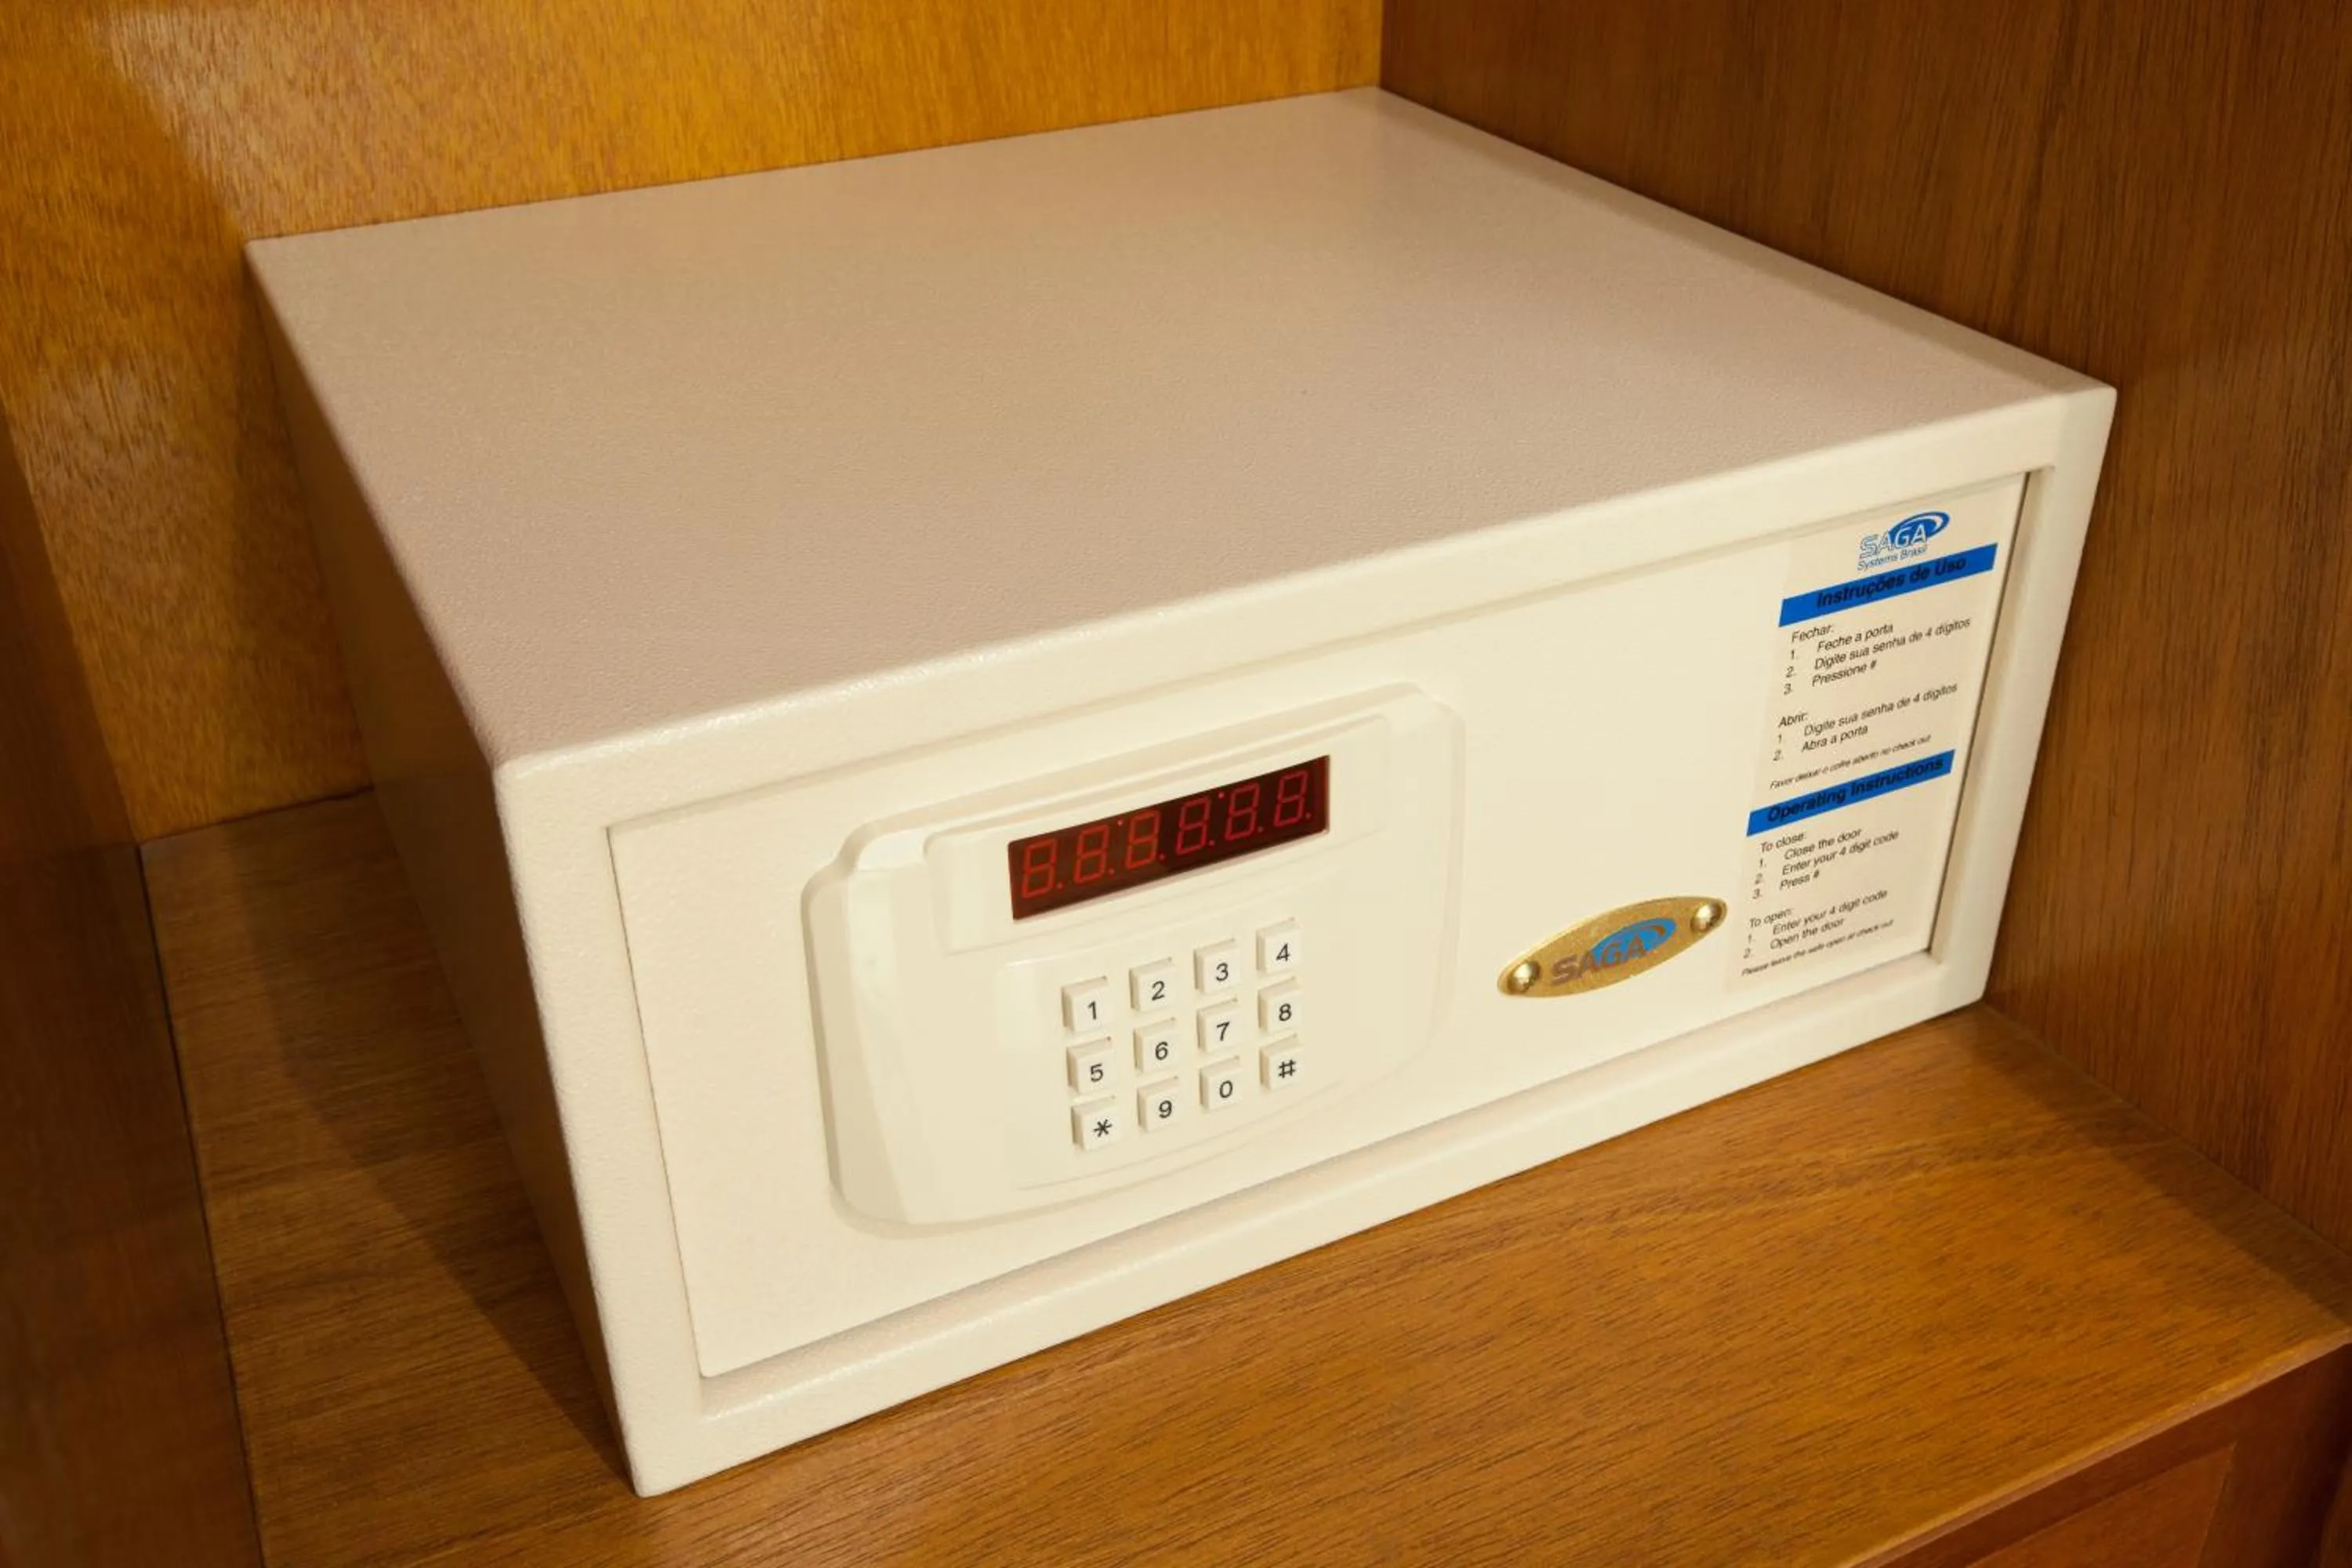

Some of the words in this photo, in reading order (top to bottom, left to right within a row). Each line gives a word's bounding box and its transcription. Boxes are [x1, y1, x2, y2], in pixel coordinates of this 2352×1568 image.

[1859, 523, 1928, 559] SAGA
[1857, 553, 1898, 572] Systems
[1900, 545, 1927, 561] Brasil
[1816, 573, 1905, 608] Instruções
[1909, 563, 1931, 584] de
[1934, 557, 1968, 576] Uso
[1814, 652, 1846, 670] Digite
[1849, 647, 1871, 660] sua
[1872, 636, 1906, 654] senha
[1908, 630, 1923, 644] de
[1925, 627, 1933, 638] 4
[1817, 635, 1853, 652] Feche
[1854, 633, 1863, 643] a
[1864, 623, 1894, 641] porta
[1812, 664, 1867, 687] Pressione
[1869, 659, 1878, 670] #
[1777, 711, 1809, 728] Abrir:
[1803, 720, 1836, 736] Digite
[1838, 713, 1859, 727] sua
[1860, 702, 1895, 720] senha
[1896, 697, 1911, 710] de
[1912, 691, 1921, 703] 4
[1801, 738, 1828, 753] Abra
[1830, 734, 1838, 745] a
[1840, 725, 1868, 745] porta
[1892, 739, 1916, 753] check
[1768, 790, 1846, 822] Operating
[1760, 841, 1774, 853] To
[1782, 858, 1812, 876] Enter
[1813, 851, 1838, 868] your
[1839, 846, 1846, 856] 4
[1849, 839, 1871, 855] digit
[1872, 830, 1900, 847] code
[1784, 843, 1816, 860] Close
[1818, 837, 1835, 850] the
[1837, 828, 1863, 844] door
[1780, 873, 1811, 891] Press
[1812, 869, 1820, 880] #
[1749, 916, 1762, 929] To
[1773, 917, 1802, 935] Enter
[1803, 909, 1827, 927] your
[1828, 904, 1836, 916] 4
[1838, 897, 1861, 913] digit
[1861, 888, 1889, 906] code
[1769, 933, 1800, 950] Open
[1802, 927, 1819, 939] the
[1820, 917, 1846, 933] door
[1550, 933, 1648, 987] SAGA
[1741, 963, 1769, 977] Please
[1770, 954, 1792, 967] leave
[1793, 949, 1806, 960] the
[1825, 935, 1846, 950] open
[1856, 924, 1880, 938] check
[1087, 1000, 1098, 1021] 1
[1150, 980, 1166, 1001] 2
[1214, 962, 1230, 982] 3
[1275, 943, 1291, 963] 4
[1089, 1063, 1105, 1083] 5
[1154, 1040, 1170, 1061] 6
[1216, 1022, 1231, 1042] 7
[1277, 1003, 1293, 1022] 8
[1157, 1099, 1174, 1119] 9
[1218, 1080, 1234, 1099] 0
[1277, 1059, 1298, 1079] #
